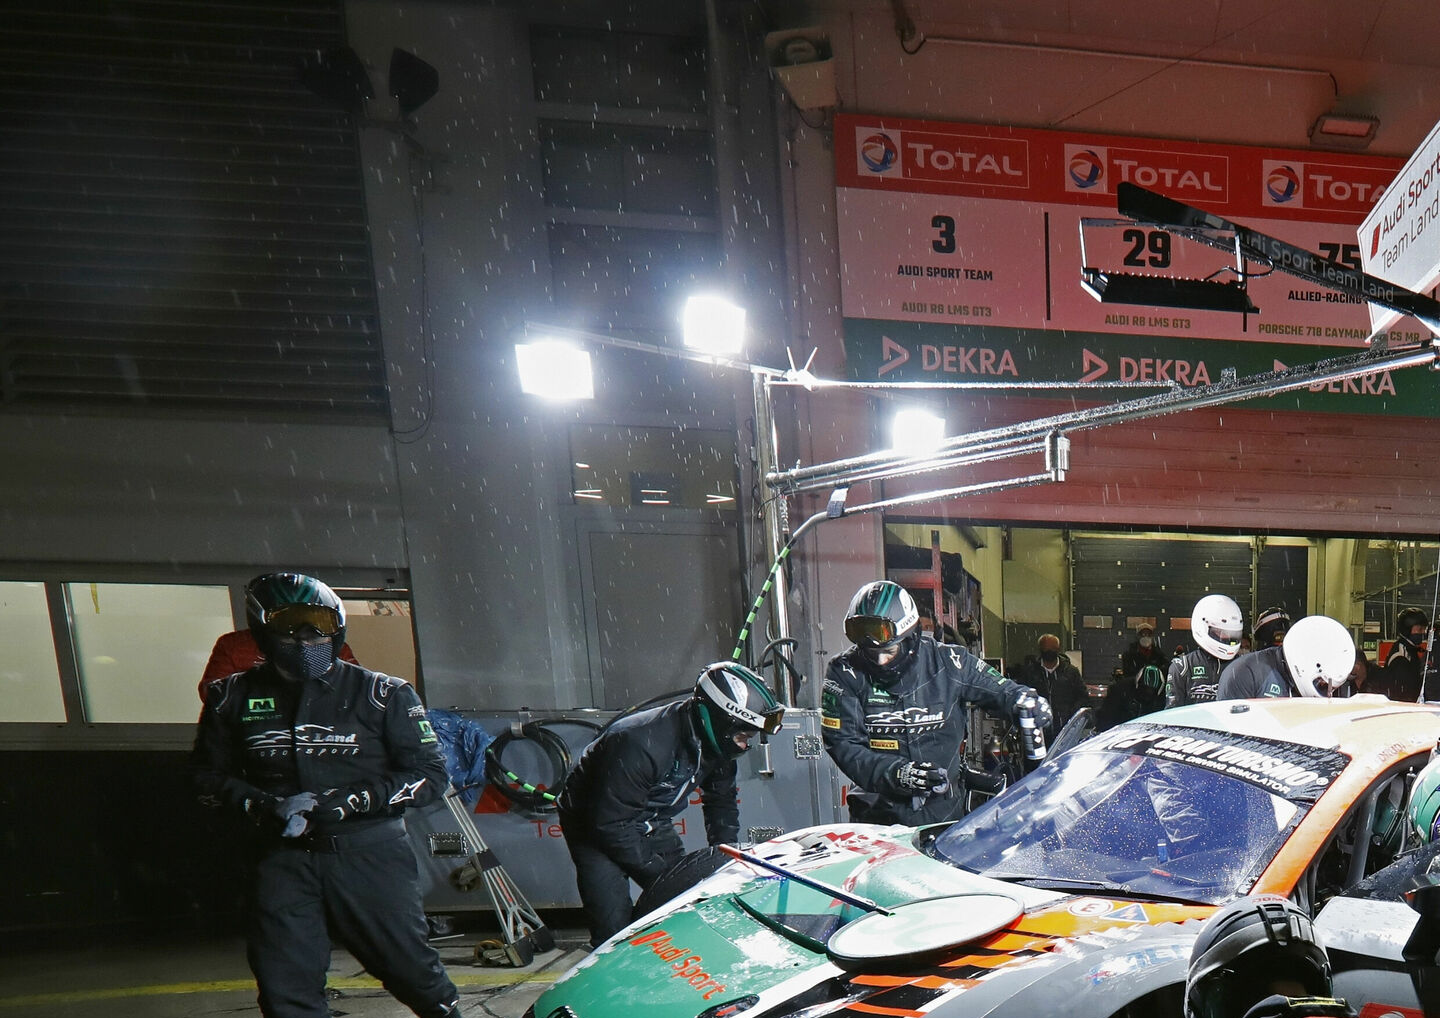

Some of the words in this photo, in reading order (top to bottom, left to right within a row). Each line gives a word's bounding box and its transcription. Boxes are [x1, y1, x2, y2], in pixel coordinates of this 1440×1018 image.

[1381, 193, 1406, 240] Audi
[1382, 231, 1409, 273] Team
[1410, 189, 1440, 243] Land
[931, 215, 956, 254] 3
[1123, 229, 1171, 268] 29
[897, 264, 923, 277] AUDI
[926, 266, 961, 280] SPORT
[964, 268, 993, 281] TEAM
[1271, 240, 1318, 274] Sport
[1320, 261, 1358, 290] Team
[1362, 274, 1395, 302] Land
[902, 302, 927, 314] AUDI
[930, 304, 944, 315] R8
[948, 305, 969, 317] LMS
[972, 307, 992, 318] GT3
[1105, 314, 1129, 326] AUDI
[1149, 317, 1169, 328] LMS
[1172, 318, 1191, 330] GT3
[1258, 324, 1303, 335] PORSCHE
[1306, 327, 1322, 337] 718
[1325, 328, 1366, 339] CAYMAN
[1406, 332, 1420, 341] MR
[921, 343, 1018, 376] DEKRA
[1120, 356, 1211, 387] DEKRA
[725, 702, 757, 723] uvex
[914, 712, 943, 723] Land
[313, 733, 356, 743] Land
[1153, 733, 1218, 752] GRAN
[1212, 745, 1319, 786] TURISMO
[1185, 754, 1227, 771] DRIVING
[1226, 766, 1291, 795] SIMULATOR
[645, 937, 691, 963] Audi
[671, 955, 728, 1000] Sport
